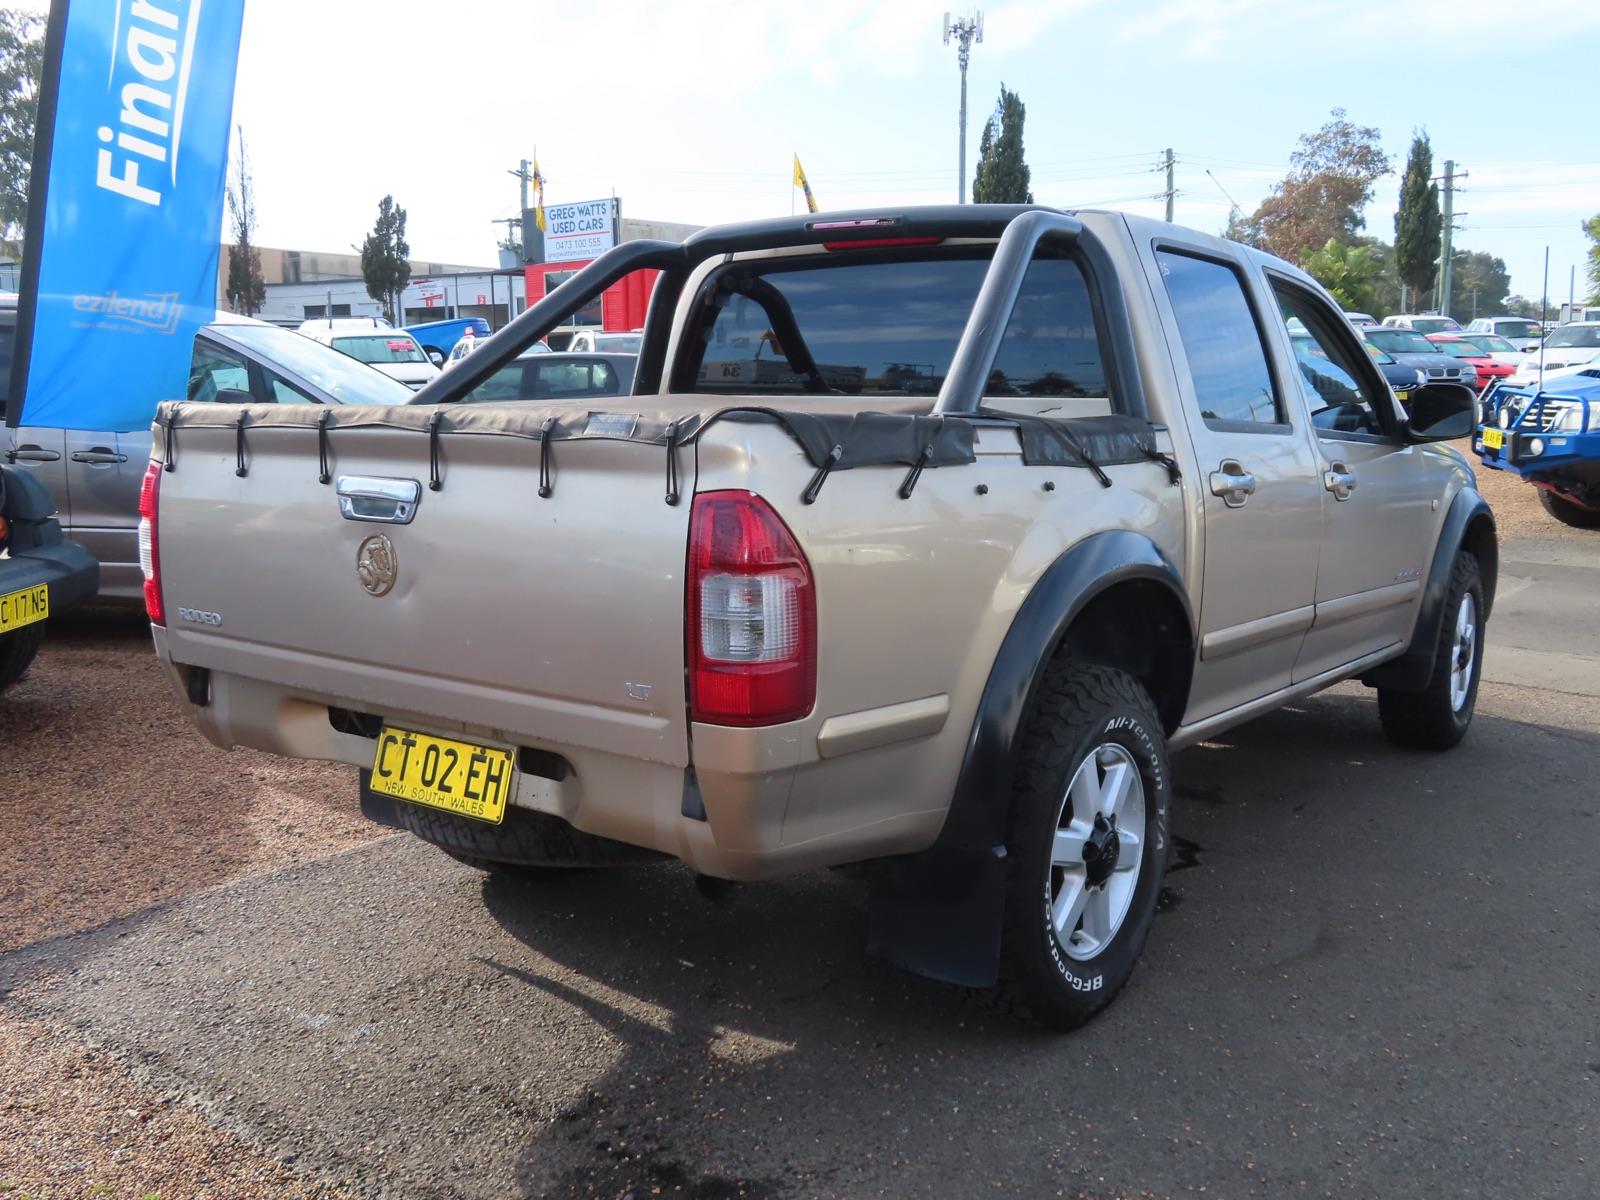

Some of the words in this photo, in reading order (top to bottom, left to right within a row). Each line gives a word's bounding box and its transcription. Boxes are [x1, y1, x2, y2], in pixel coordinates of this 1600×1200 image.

[548, 207, 576, 221] GREG
[577, 203, 607, 217] WATTS
[552, 221, 576, 234] USED
[578, 217, 604, 231] CARS
[555, 240, 573, 251] 0473
[574, 238, 587, 249] 100
[588, 237, 602, 248] 555
[14, 594, 27, 620] 17
[31, 589, 47, 615] NS
[176, 607, 222, 627] RODEO
[384, 781, 407, 796] NEW
[411, 787, 445, 806] SOUTH
[450, 799, 485, 816] WALES
